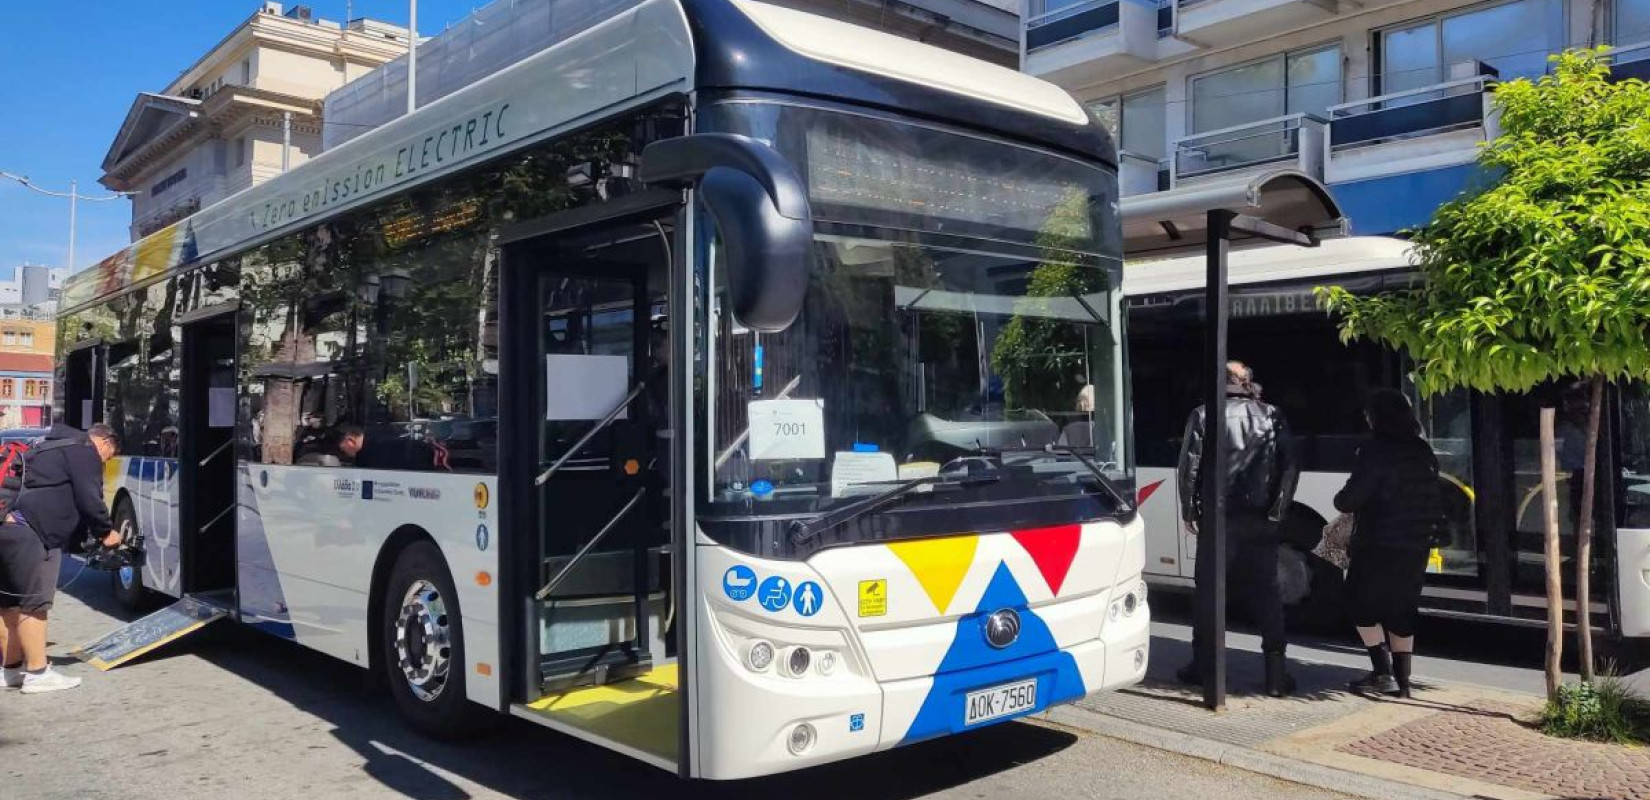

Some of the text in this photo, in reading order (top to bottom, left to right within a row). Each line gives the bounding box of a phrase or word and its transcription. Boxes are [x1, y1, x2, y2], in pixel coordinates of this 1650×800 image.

[262, 103, 510, 229] Zero emission ELECTRIC
[773, 422, 805, 436] 7001
